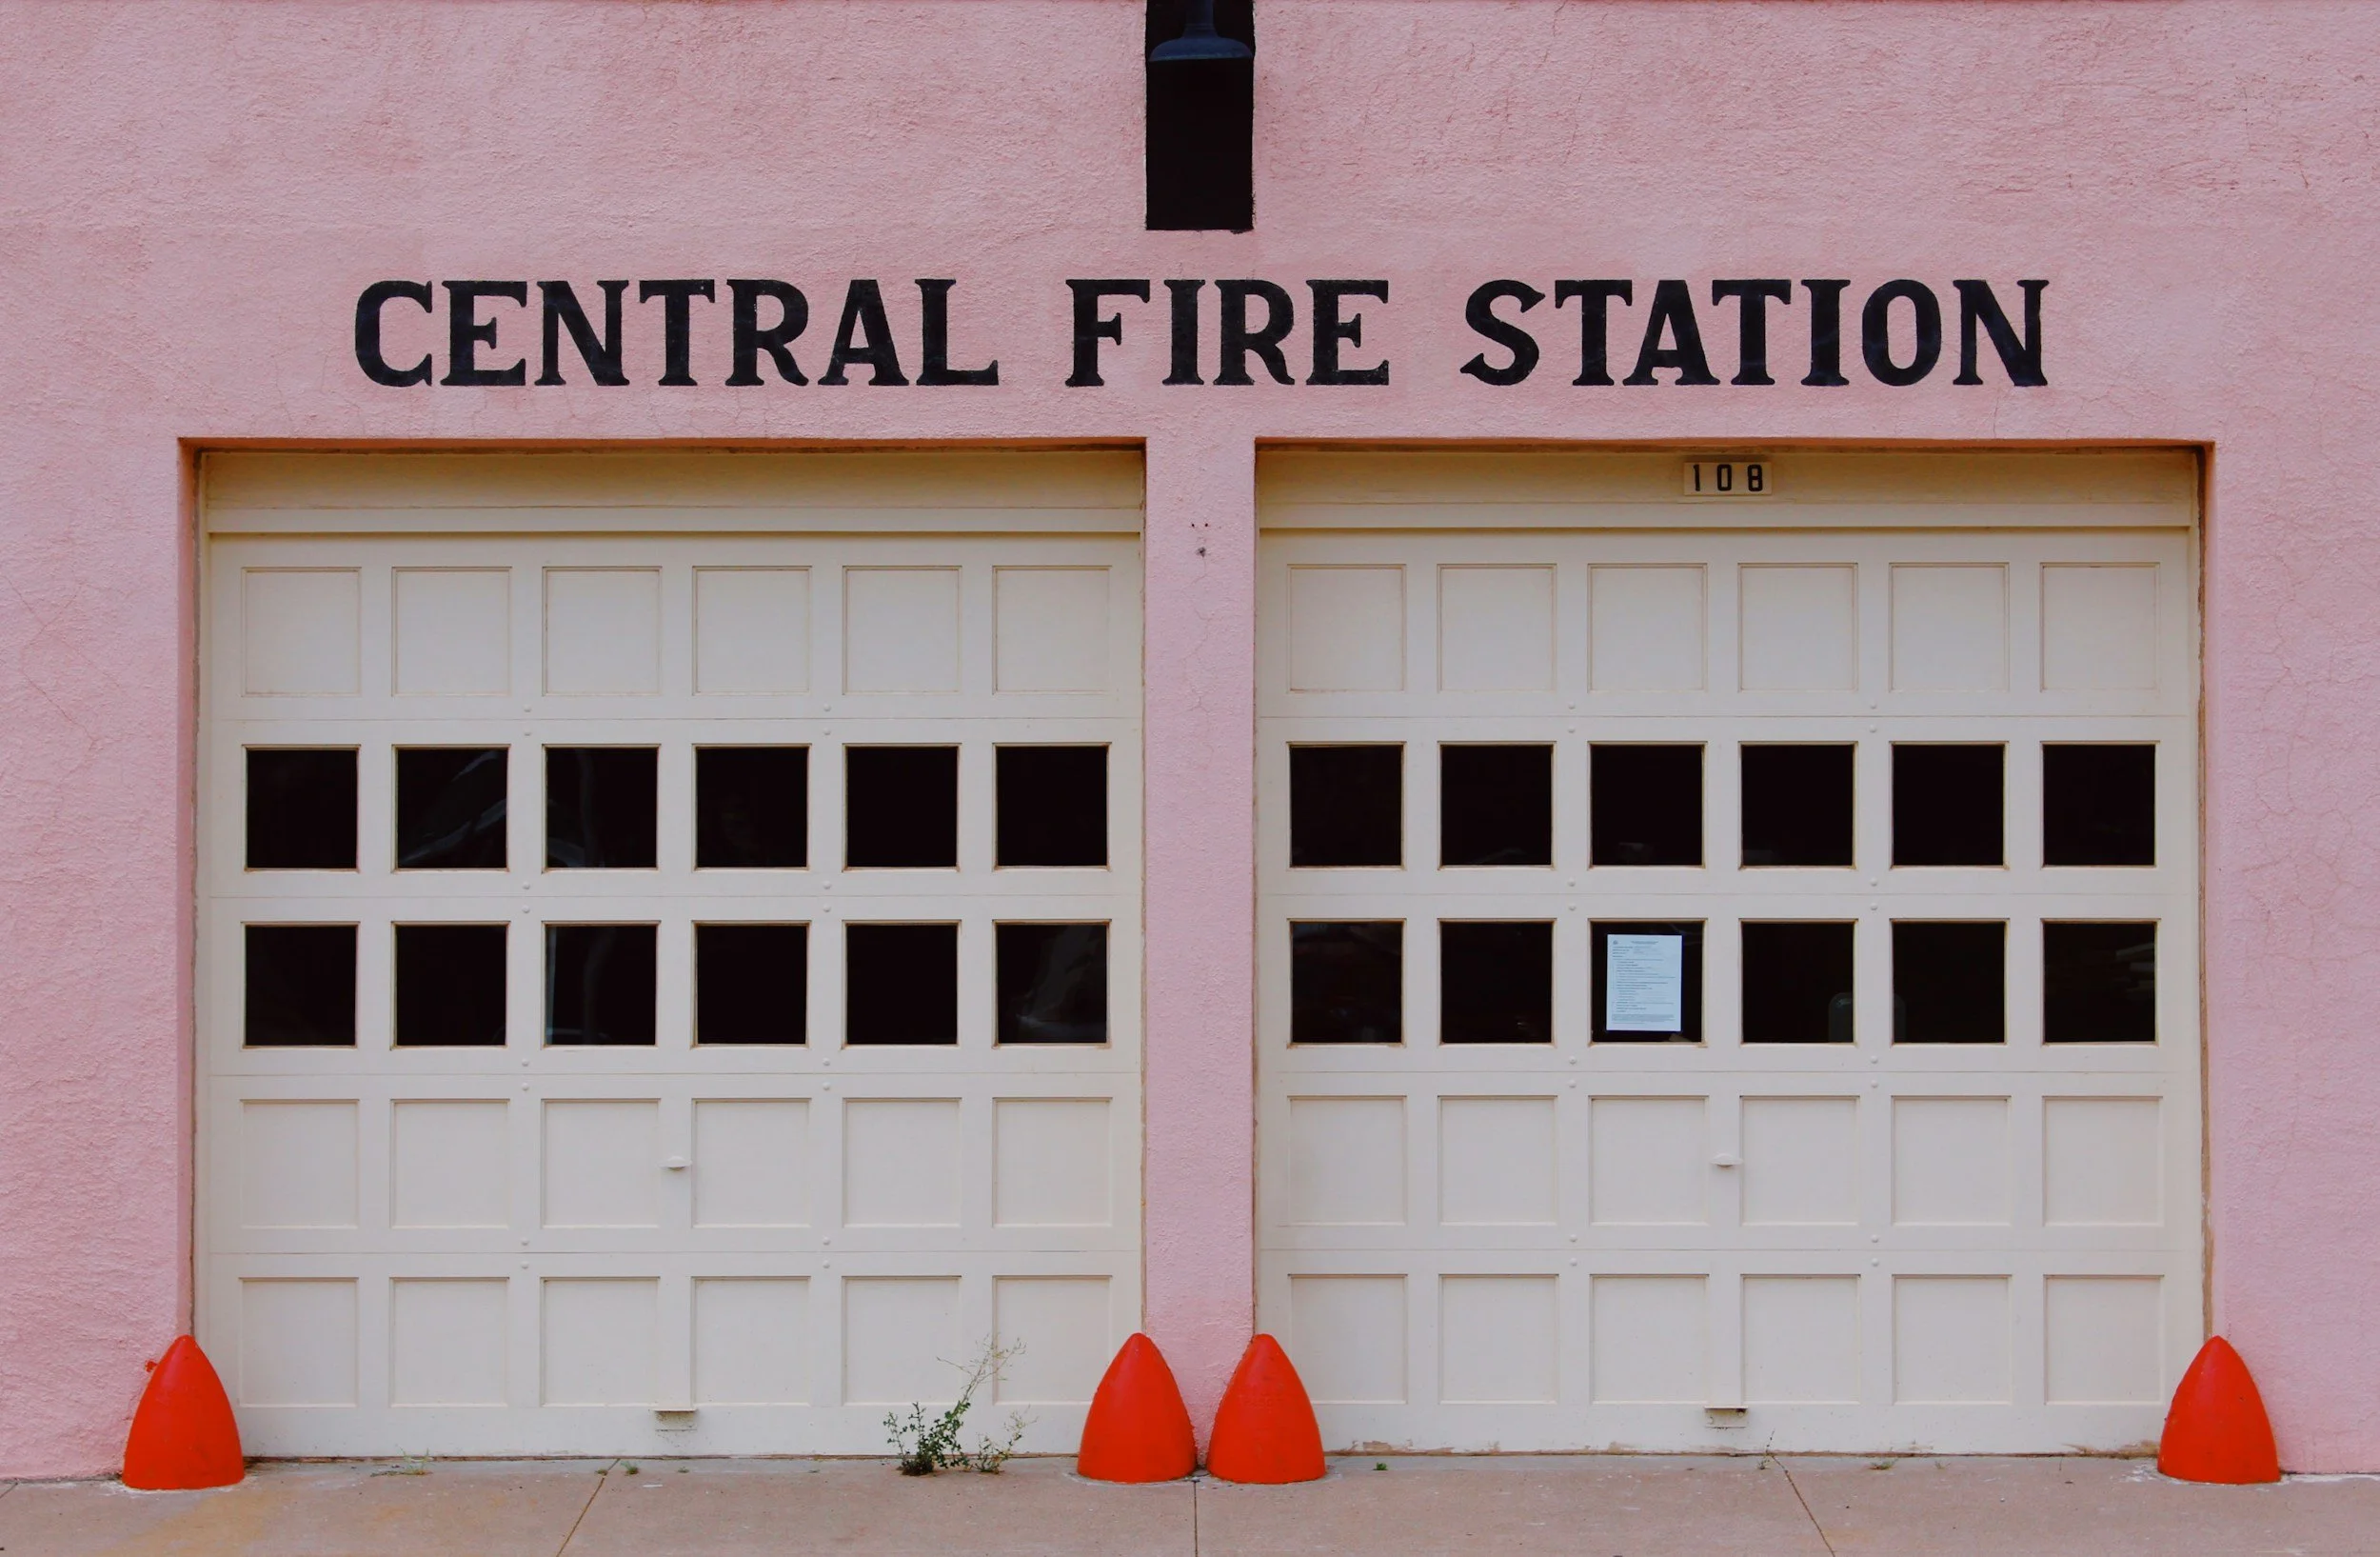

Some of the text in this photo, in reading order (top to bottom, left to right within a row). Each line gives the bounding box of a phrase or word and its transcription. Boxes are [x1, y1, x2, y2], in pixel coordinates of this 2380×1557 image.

[355, 279, 2049, 388] CENTRAL FIRE STATION
[1693, 464, 1763, 491] 108
